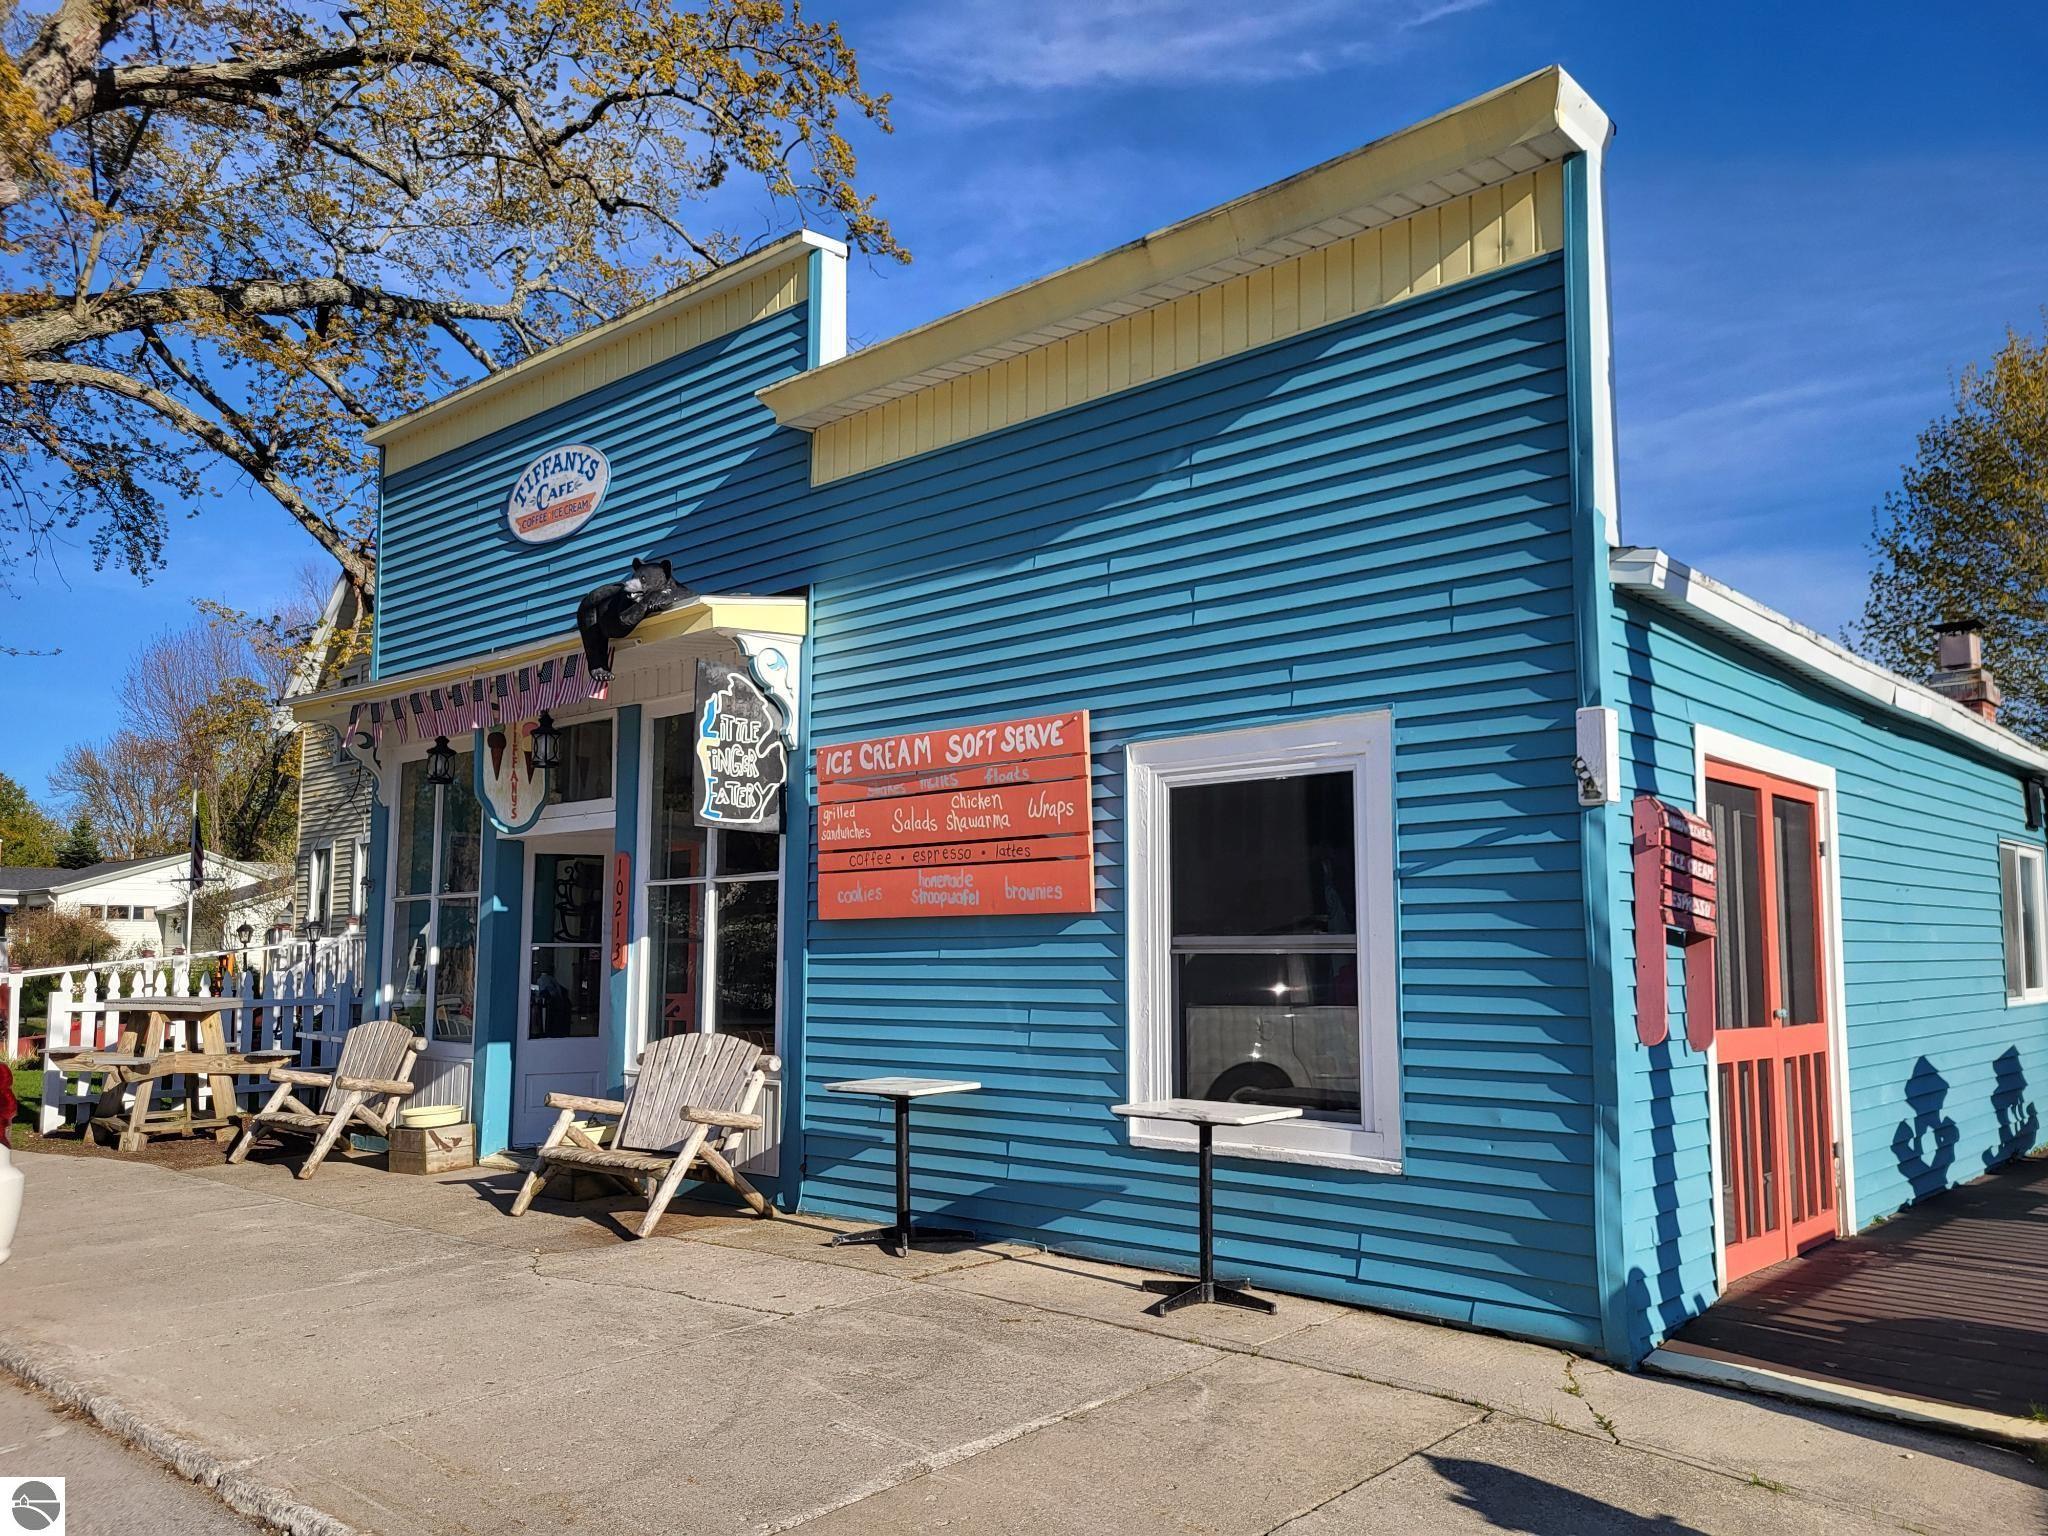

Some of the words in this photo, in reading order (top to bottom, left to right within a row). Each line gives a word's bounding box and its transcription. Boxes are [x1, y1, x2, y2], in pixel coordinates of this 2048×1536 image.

[514, 451, 600, 508] TIFFANYS
[536, 481, 576, 511] CAFE
[522, 512, 548, 529] COFFEE
[551, 508, 565, 520] ICE
[563, 500, 589, 516] CREAM
[825, 749, 852, 775] ICE
[859, 735, 932, 771] CREAM
[945, 728, 998, 764] SOFT
[1000, 719, 1064, 753] SERVE
[984, 765, 1030, 785] floats
[823, 804, 856, 827] grilled
[891, 806, 938, 833] Salads
[1028, 790, 1074, 825] Wraps
[821, 820, 872, 841] sandwiches
[849, 852, 892, 868] coffee
[912, 847, 972, 864] espresso
[995, 843, 1031, 859] lattes
[837, 879, 883, 904] cookies
[1004, 875, 1064, 902] brownies
[917, 867, 974, 889] homemade
[611, 857, 624, 962] 10213
